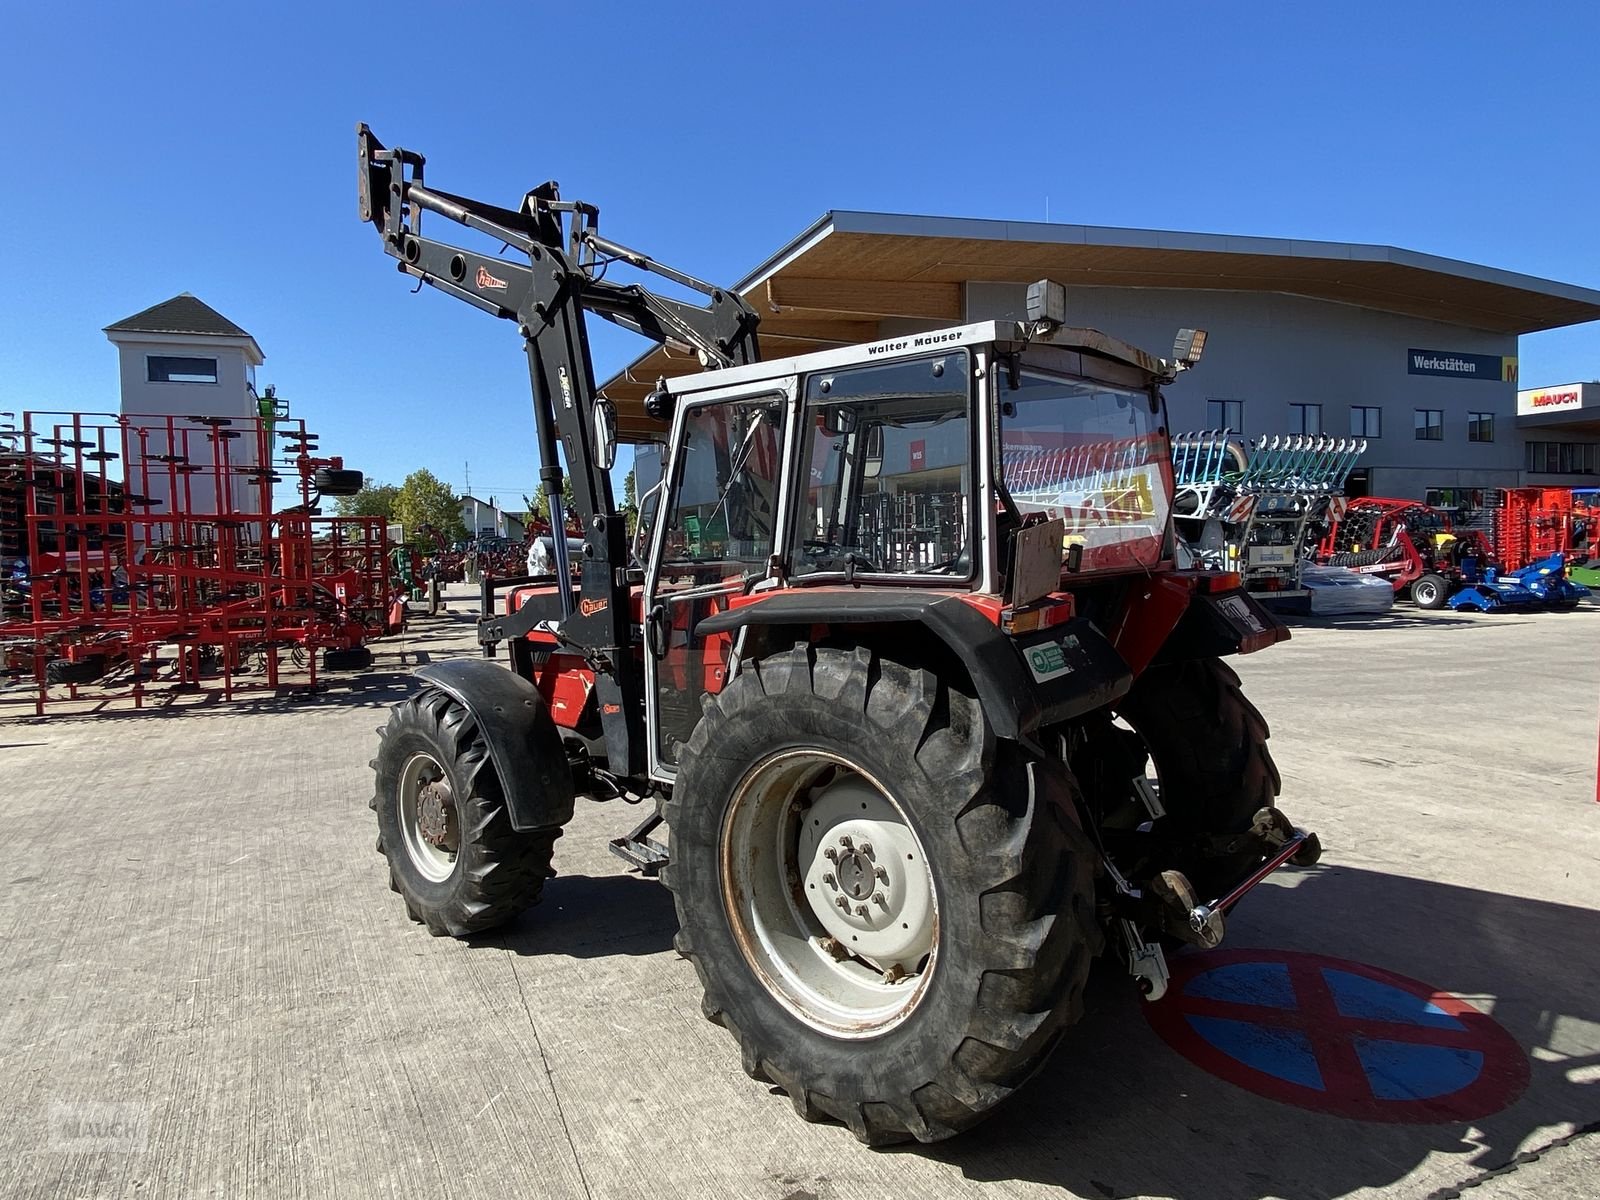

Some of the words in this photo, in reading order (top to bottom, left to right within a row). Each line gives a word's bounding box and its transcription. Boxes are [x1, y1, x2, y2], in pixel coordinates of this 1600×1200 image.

[867, 340, 908, 355] Walter
[914, 331, 963, 347] Mauser
[1413, 355, 1476, 373] Werkstätten
[1533, 391, 1578, 407] MAUCH
[582, 599, 608, 614] hauer
